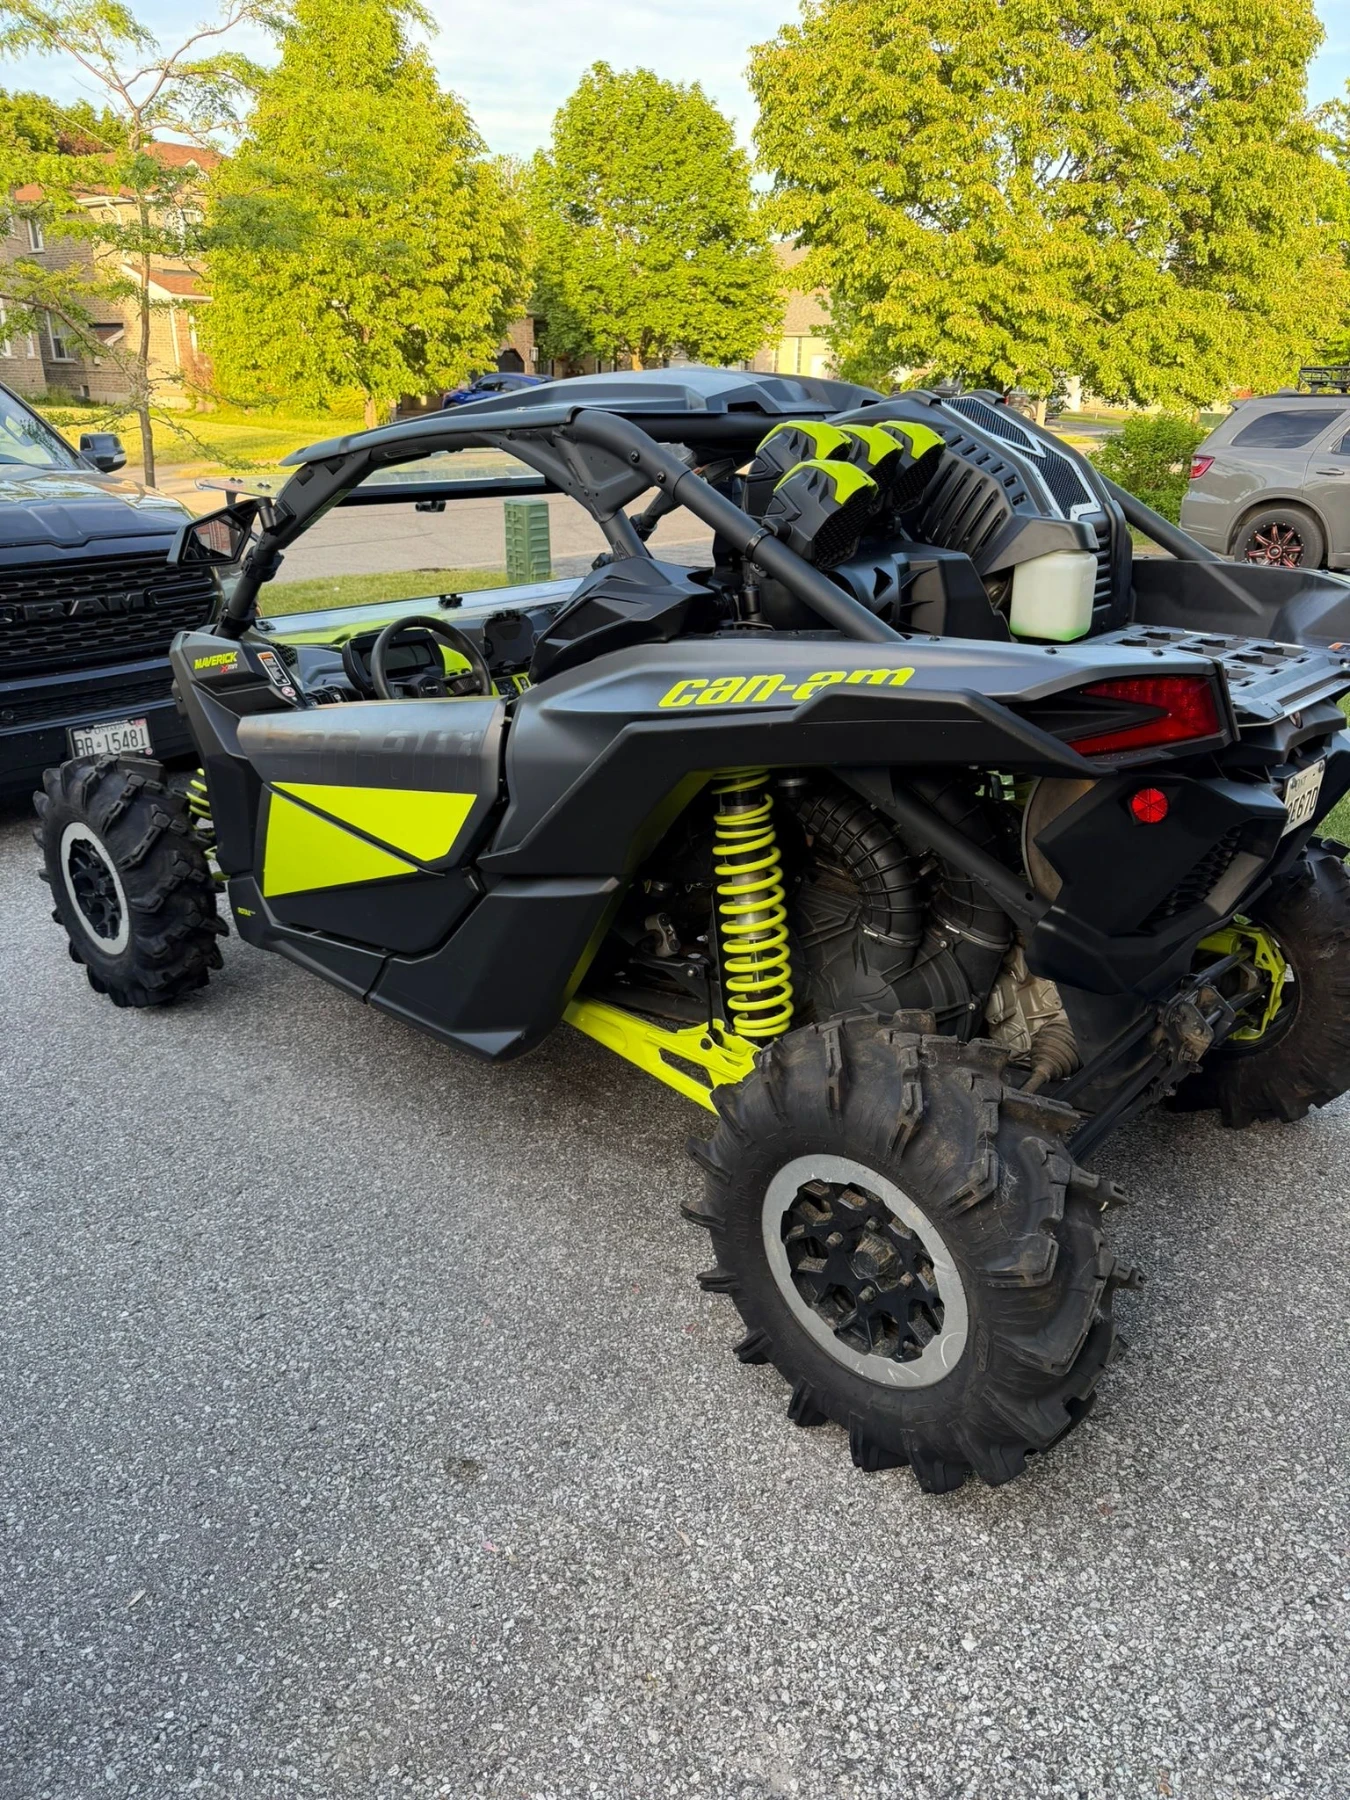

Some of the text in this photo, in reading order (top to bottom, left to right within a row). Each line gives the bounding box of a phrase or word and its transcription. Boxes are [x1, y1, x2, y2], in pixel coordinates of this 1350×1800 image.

[24, 592, 144, 622] RAM
[194, 652, 238, 670] MAVERICK
[658, 667, 915, 707] can-am
[104, 728, 146, 752] 15481
